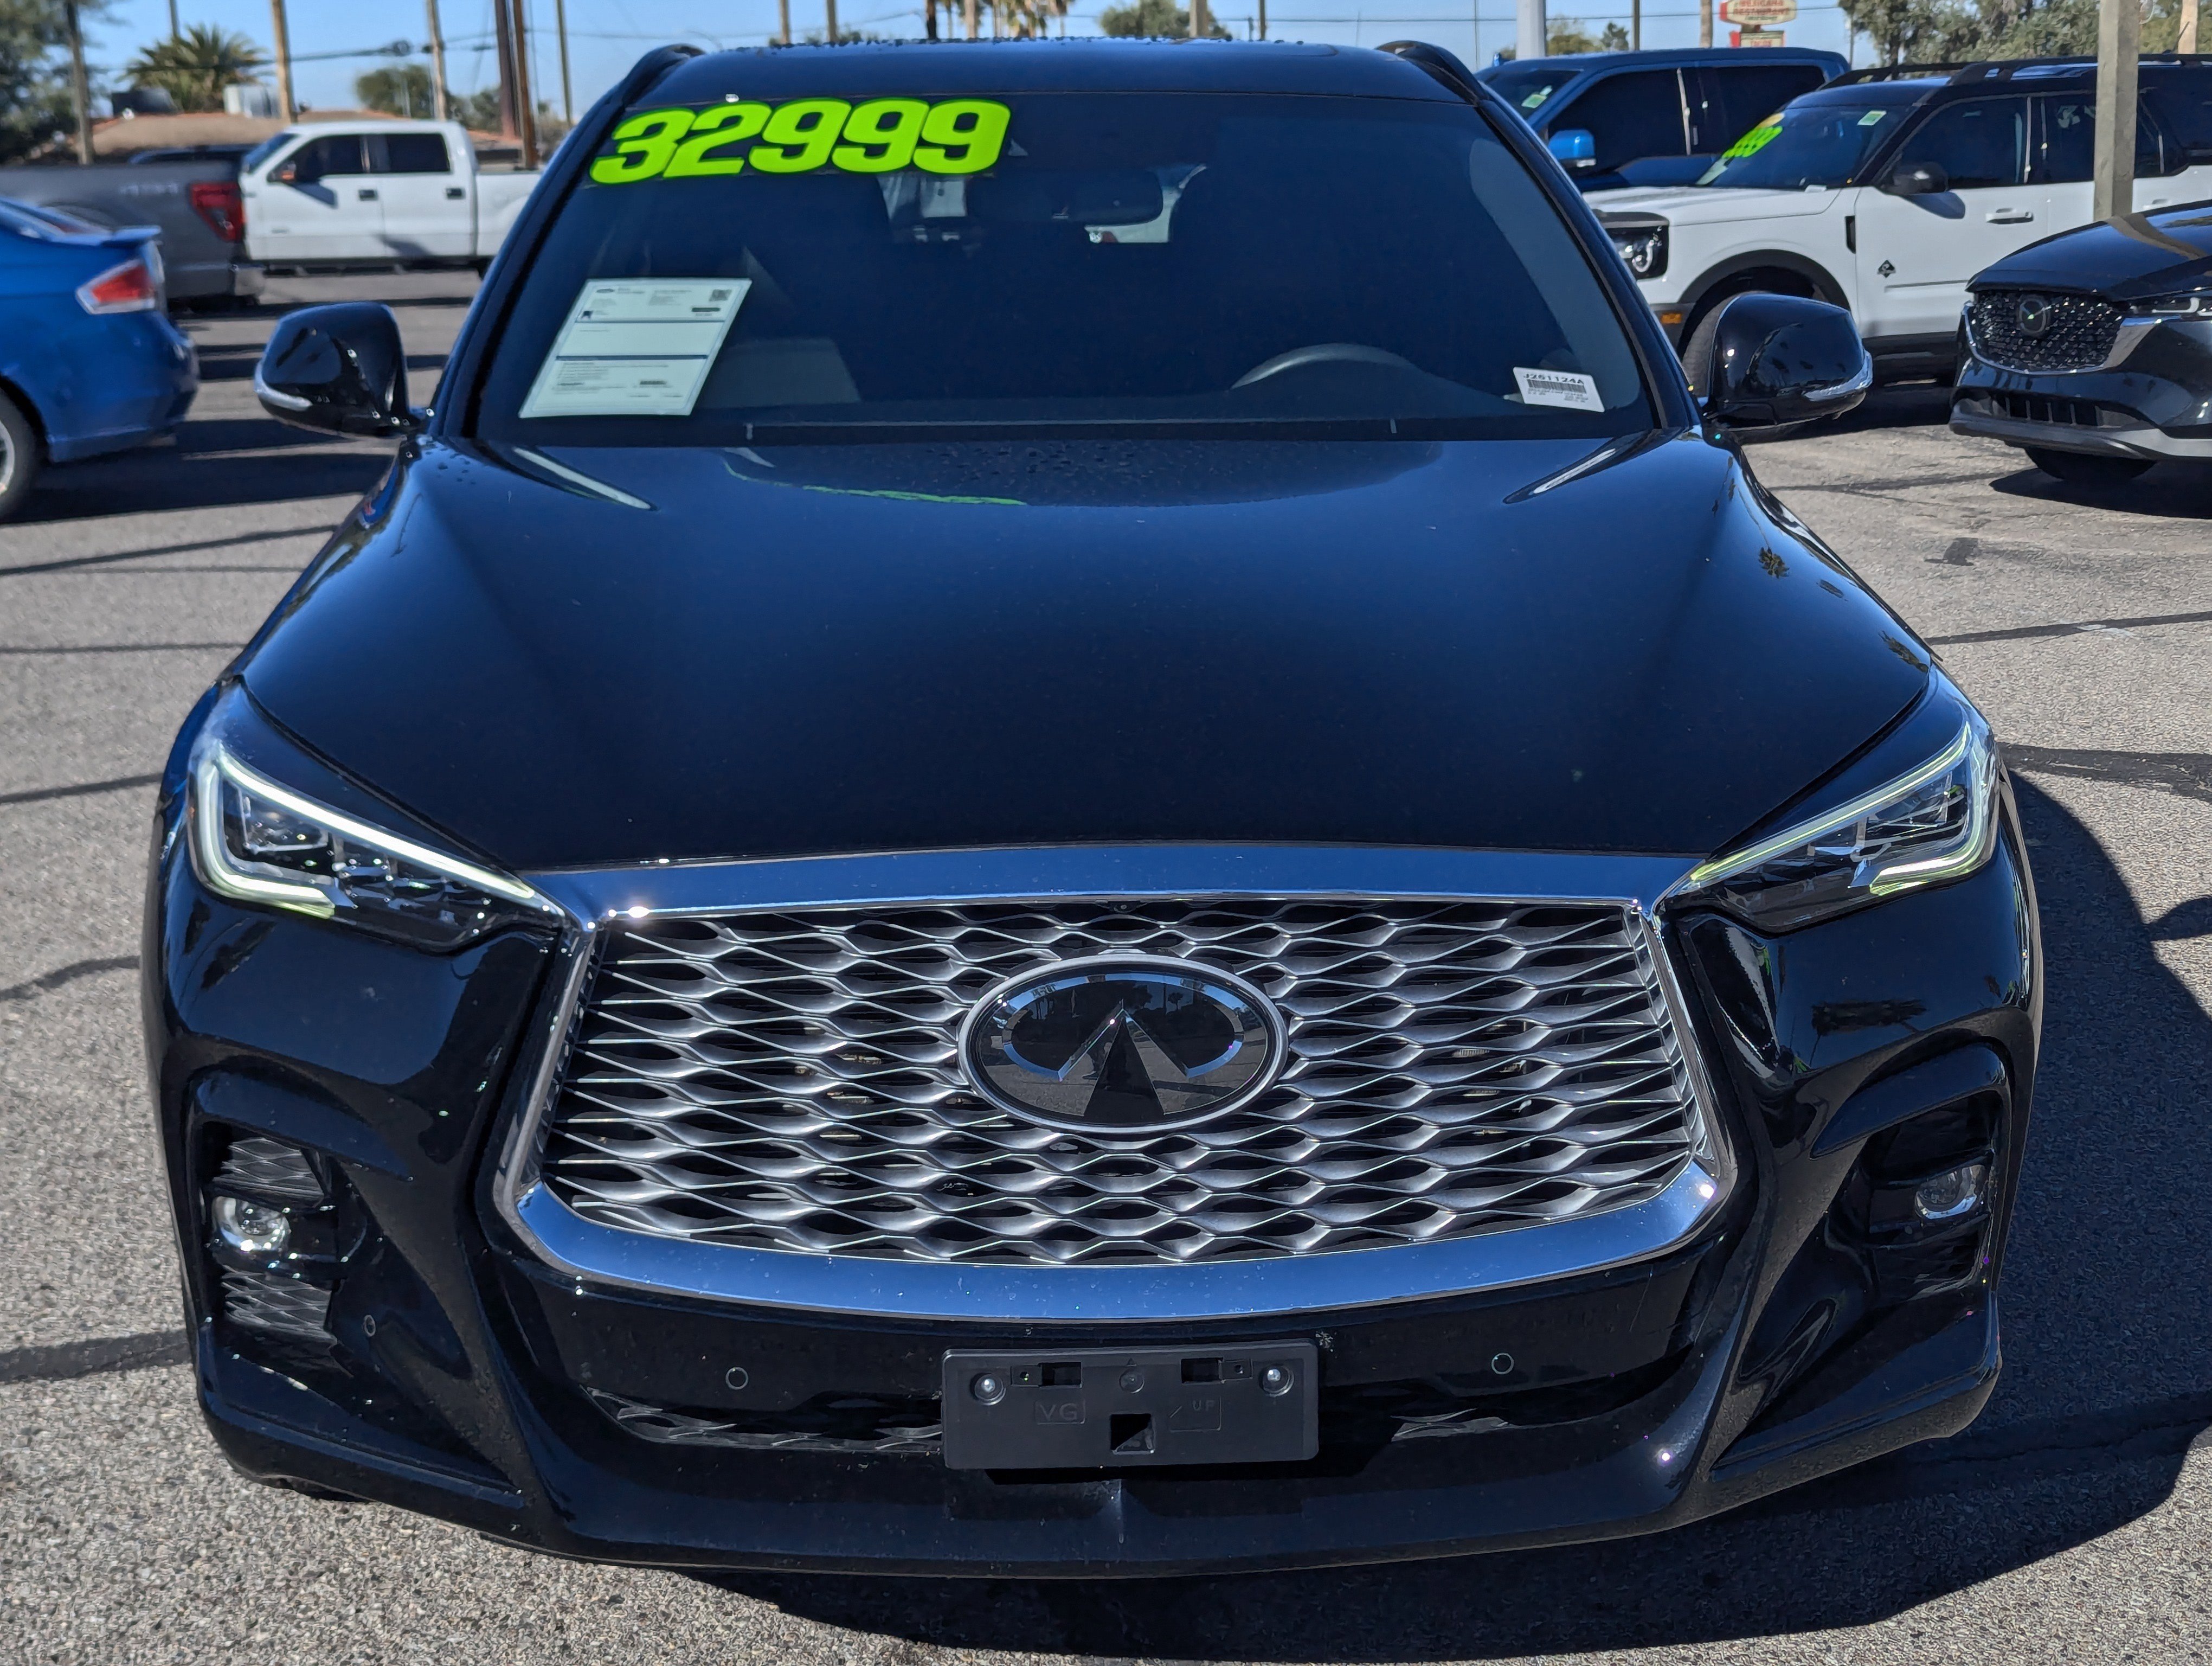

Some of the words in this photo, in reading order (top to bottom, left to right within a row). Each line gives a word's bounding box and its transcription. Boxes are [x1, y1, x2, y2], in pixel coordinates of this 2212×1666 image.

[590, 98, 1011, 184] 32999
[1039, 1402, 1078, 1421] VG
[1193, 1399, 1215, 1412] UP
